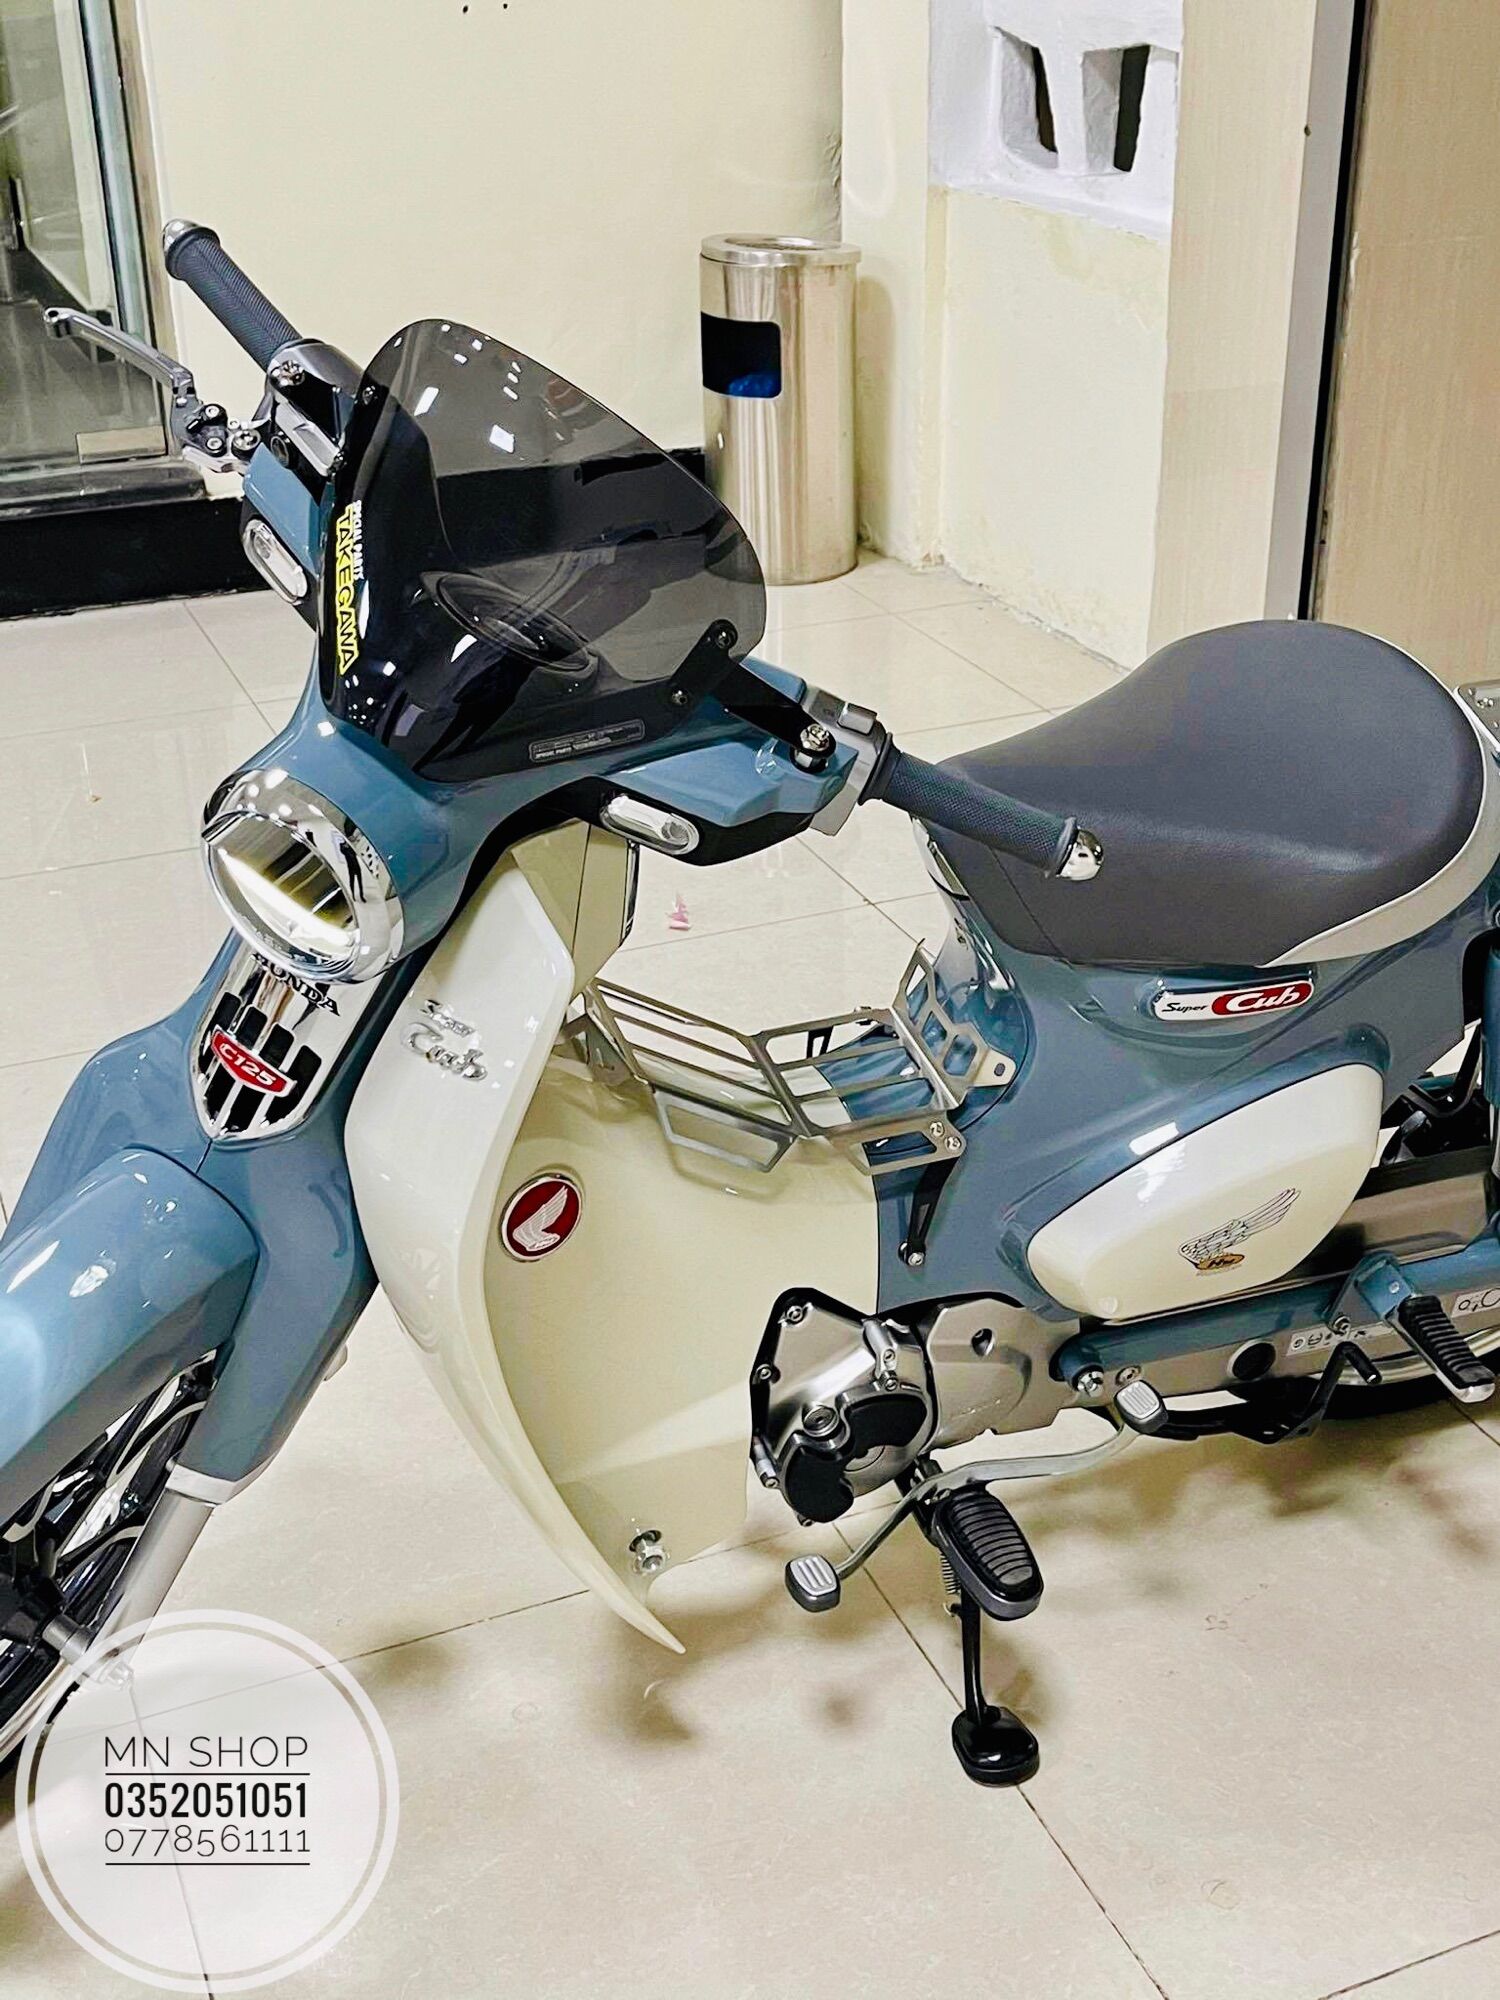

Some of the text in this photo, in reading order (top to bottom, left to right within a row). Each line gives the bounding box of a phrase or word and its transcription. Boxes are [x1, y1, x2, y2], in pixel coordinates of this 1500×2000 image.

[336, 502, 359, 676] TAKEGAWA
[252, 953, 341, 1017] HONDA
[1162, 986, 1299, 1014] Super Cub
[219, 1042, 277, 1087] C125
